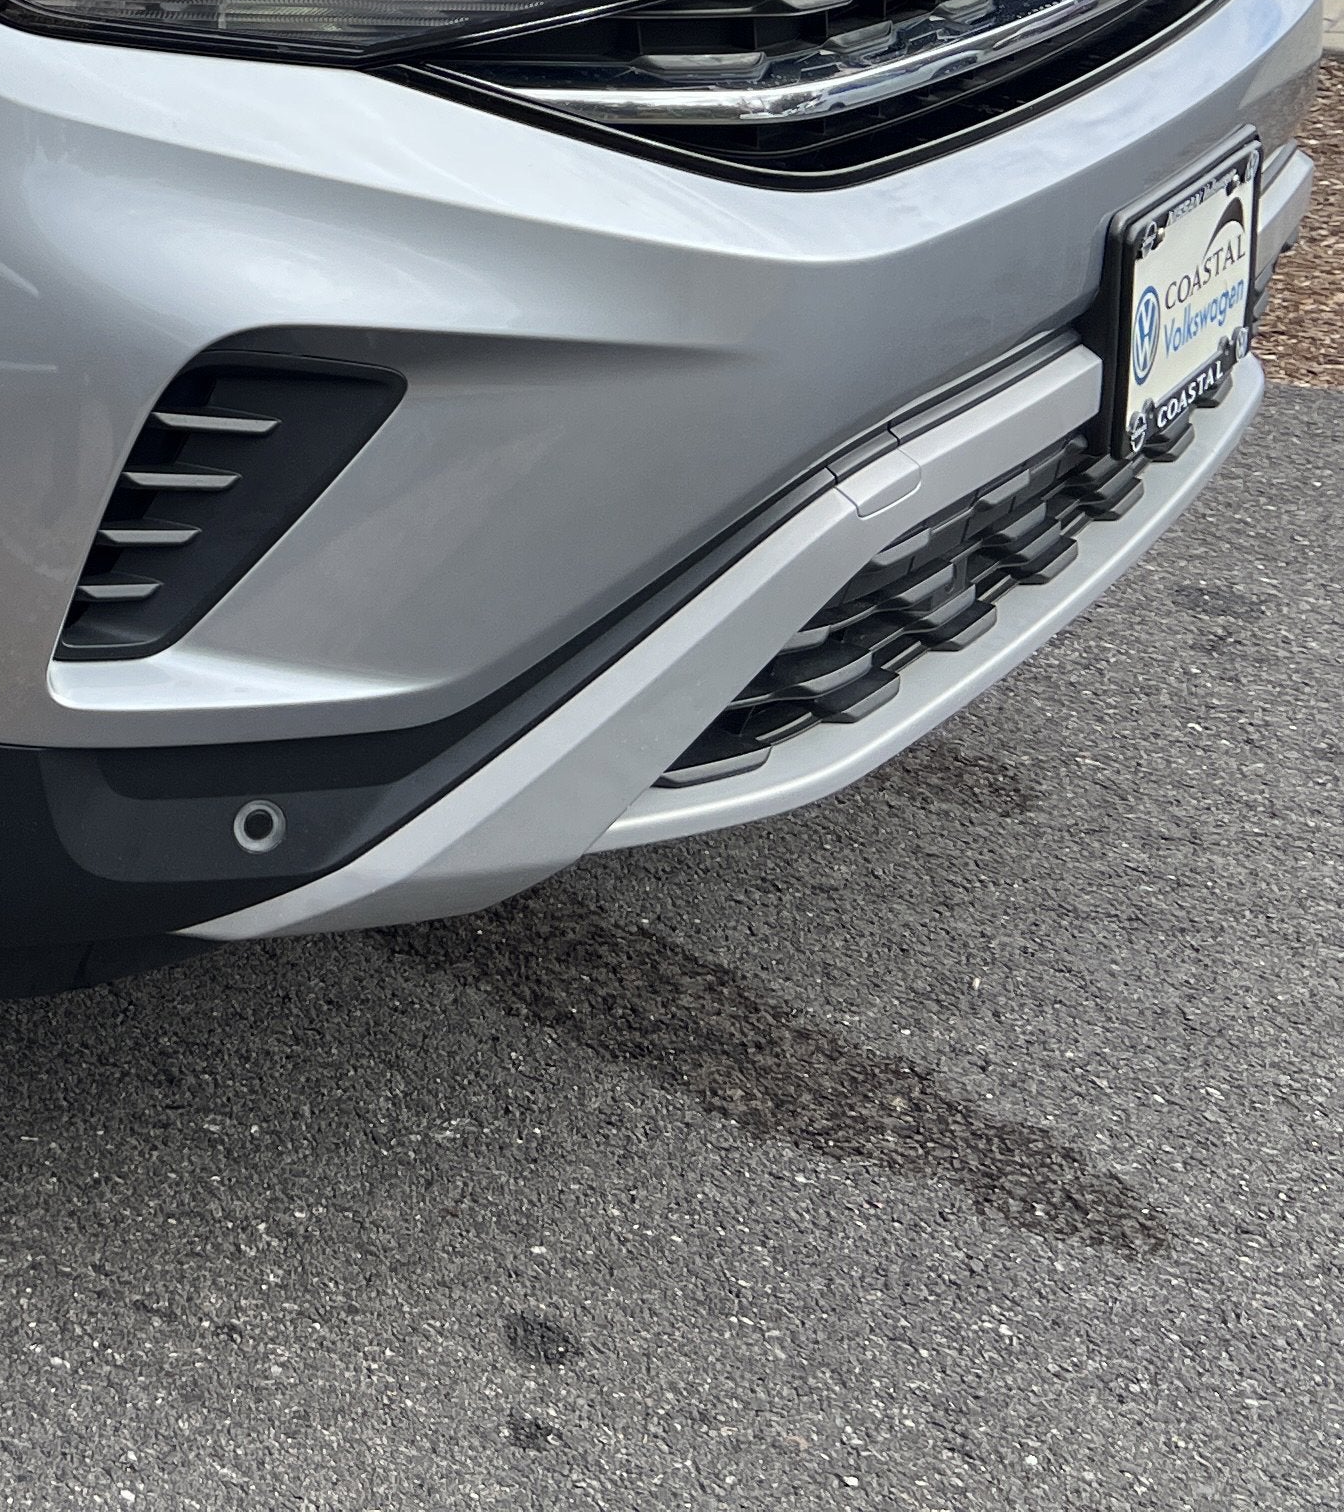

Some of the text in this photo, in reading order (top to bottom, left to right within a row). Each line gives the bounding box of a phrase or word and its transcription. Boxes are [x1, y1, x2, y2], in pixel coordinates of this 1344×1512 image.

[1164, 234, 1246, 310] COASTAL
[1163, 278, 1244, 359] Volkswagen
[1156, 363, 1224, 429] COASTAL
